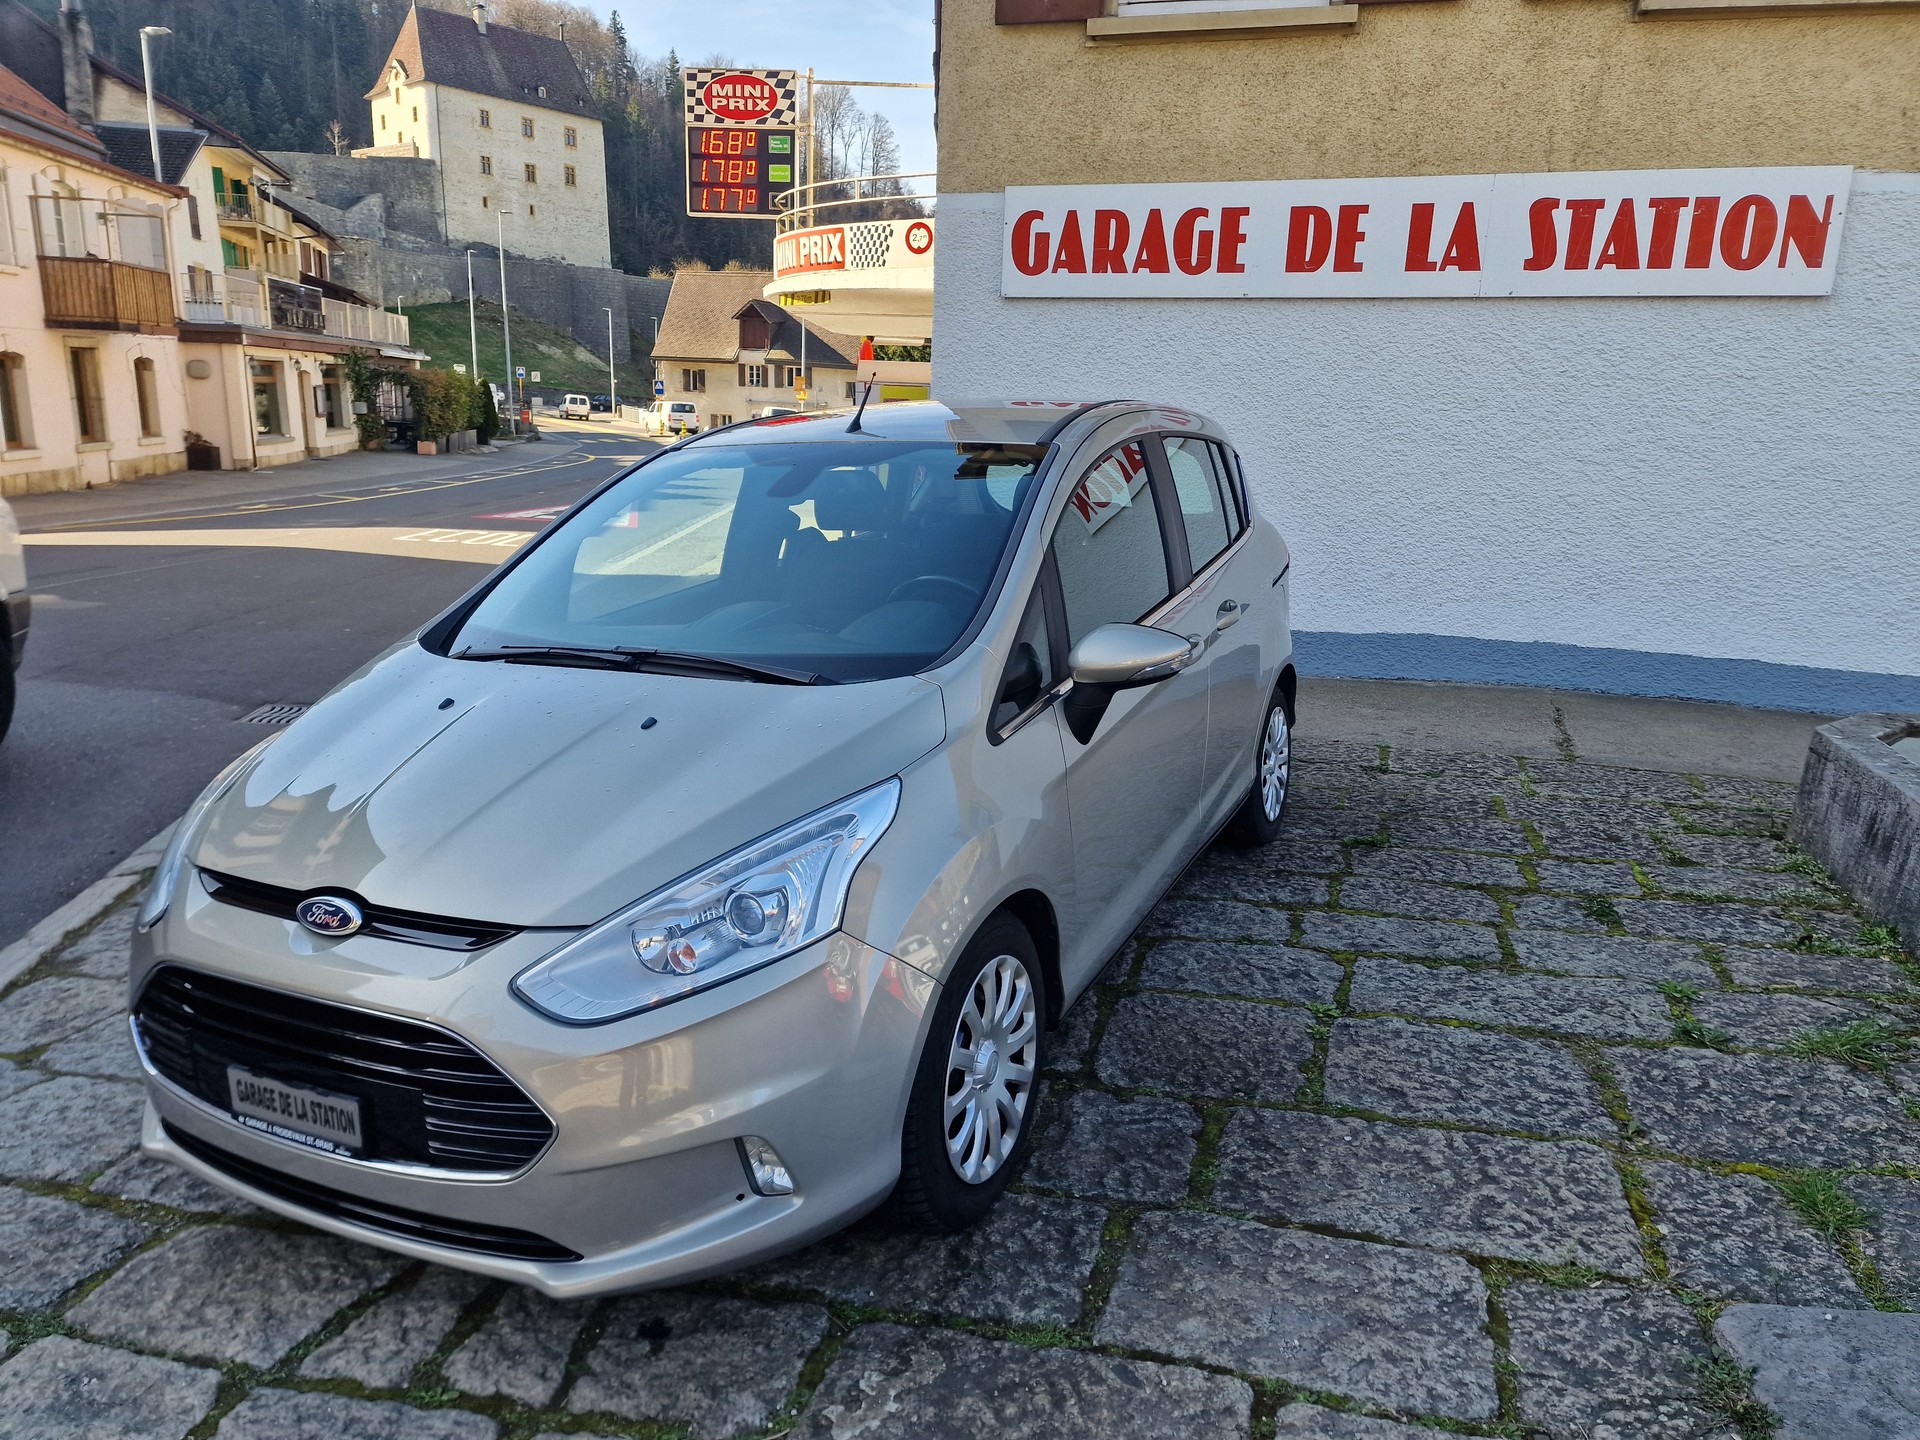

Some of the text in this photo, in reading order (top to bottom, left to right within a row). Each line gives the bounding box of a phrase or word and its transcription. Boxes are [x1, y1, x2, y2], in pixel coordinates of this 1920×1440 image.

[711, 84, 770, 98] MINI
[711, 98, 771, 111] PRIX
[1011, 194, 1835, 276] GARAGE DE LA STATION
[799, 233, 844, 266] PRIX
[392, 528, 534, 547] ECOL
[307, 903, 344, 928] Ford
[236, 1079, 356, 1137] GARAGE DE LA STATION
